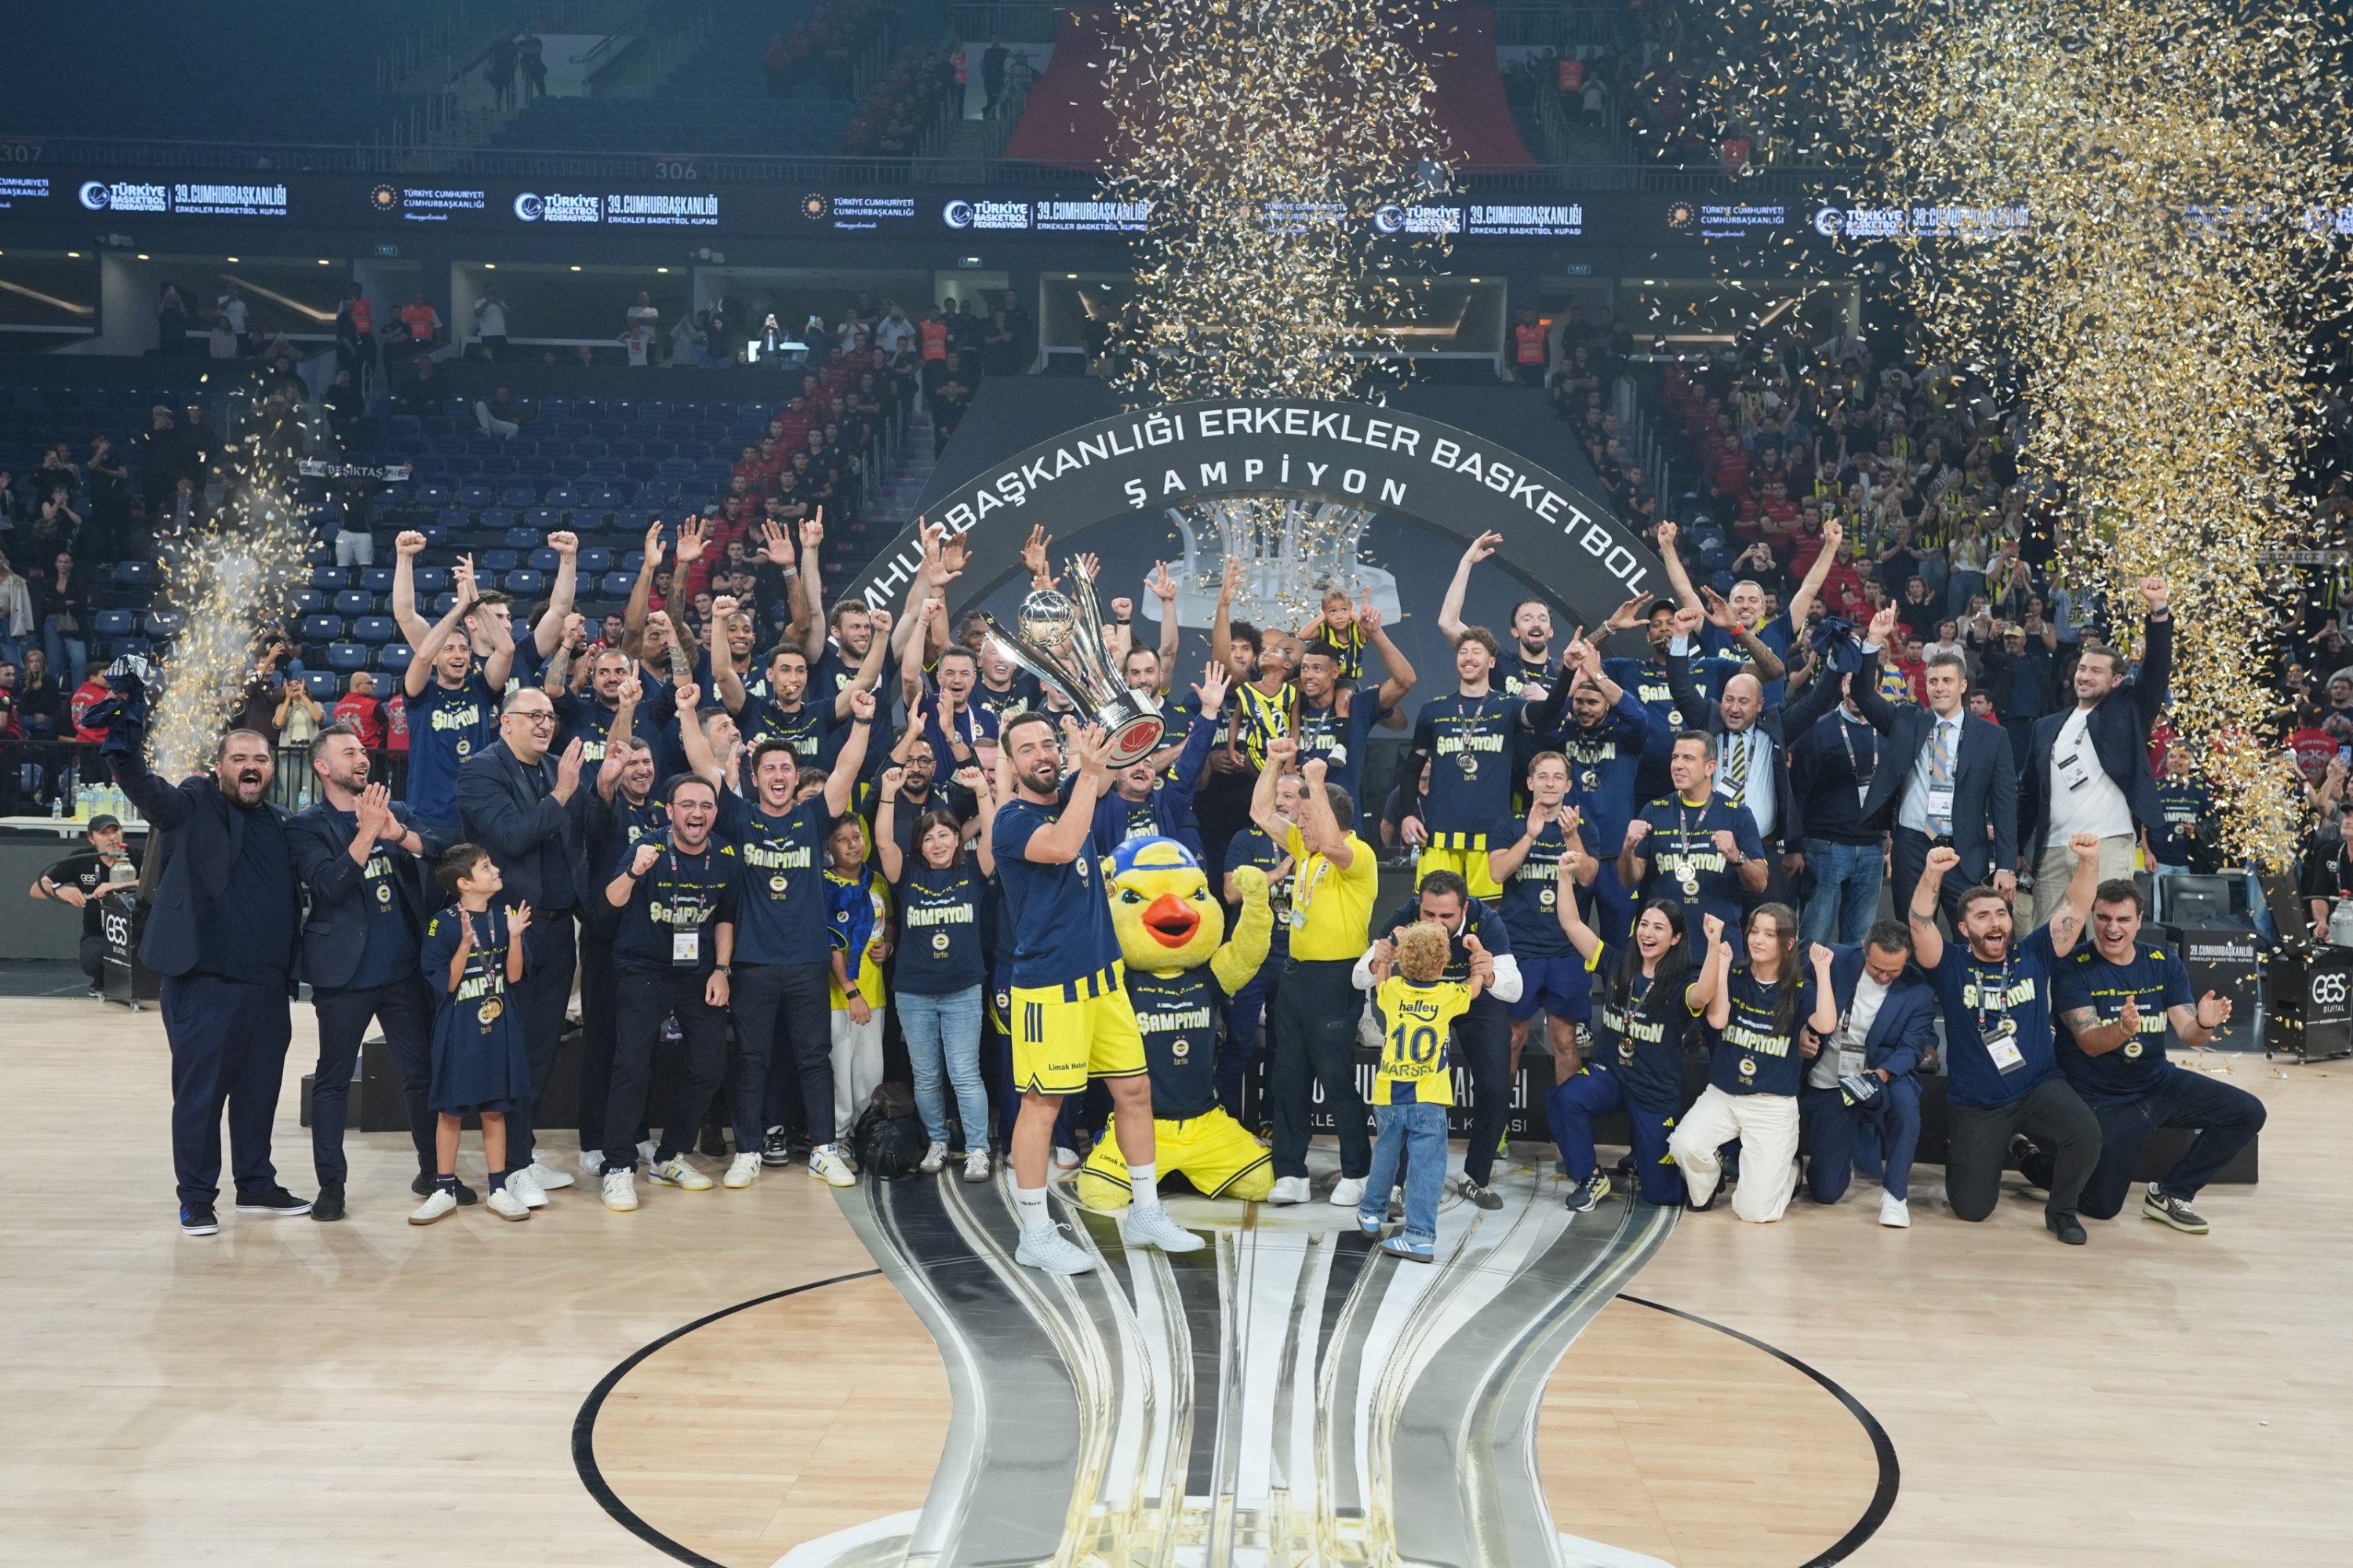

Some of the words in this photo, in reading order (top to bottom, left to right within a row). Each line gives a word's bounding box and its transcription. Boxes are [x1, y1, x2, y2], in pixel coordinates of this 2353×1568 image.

[655, 162, 697, 180] 306
[110, 182, 165, 197] TÜRKİYE
[403, 188, 433, 198] TÜRKİYE
[435, 190, 484, 199] CUMHURİYETİ
[110, 195, 165, 205] BASKETBOL
[403, 199, 484, 209] CUMHURBAŞKANLIĞI
[544, 194, 598, 208] TÜRKİYE
[834, 197, 863, 206] TÜRKİYE
[864, 198, 914, 207] CUMHURİYETİ
[110, 203, 165, 212] FEDERASYONU
[544, 206, 598, 216] BASKETBOL
[834, 207, 914, 217] CUMHURBAŞKANLIĞI
[973, 201, 1027, 214] TÜRKİYE
[1406, 205, 1460, 219] TÜRKİYE
[1701, 206, 1731, 214] TÜRKİYE
[973, 213, 1027, 222] BASKETBOL
[1701, 215, 1784, 225] CUMHURBAŞKANLIĞI
[973, 220, 1027, 229] FEDERASYONU
[328, 464, 384, 478] BEŞİKTAŞ
[1124, 453, 1407, 509] ŞAMPİYON
[1199, 407, 1420, 457] ERKEKLER
[1430, 438, 1657, 598] BASKETBOL
[743, 842, 811, 868] ŞAMPİYON
[1684, 896, 1698, 904] tarfin
[907, 902, 973, 929] ŞAMPİYON
[1399, 999, 1438, 1021] halley
[2323, 1005, 2345, 1013] DİJİTAL
[1136, 1006, 1210, 1036] ŞAMPİYON
[1391, 1023, 1438, 1064] 10
[1048, 1063, 1070, 1071] Limak
[1071, 1061, 1087, 1070] Hotels
[1173, 1057, 1189, 1065] tarfin
[1739, 1074, 1753, 1086] tarfin
[1100, 1154, 1118, 1166] Limak
